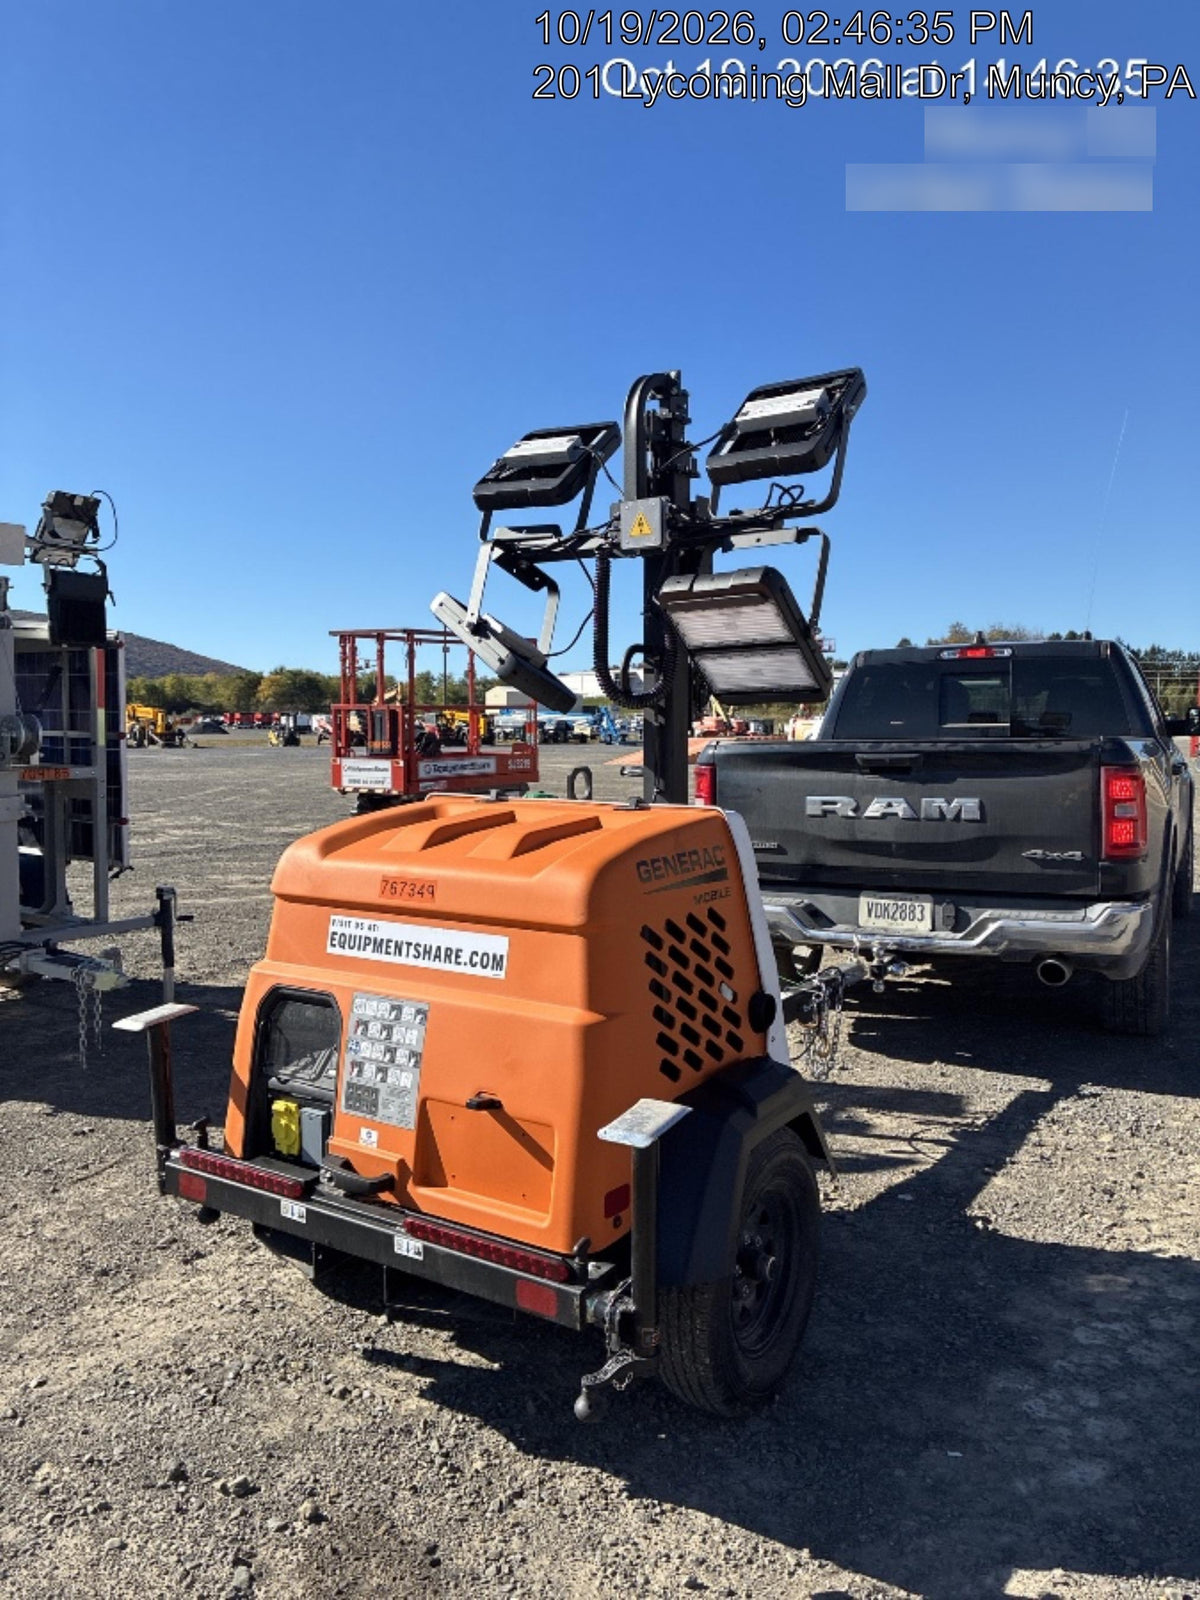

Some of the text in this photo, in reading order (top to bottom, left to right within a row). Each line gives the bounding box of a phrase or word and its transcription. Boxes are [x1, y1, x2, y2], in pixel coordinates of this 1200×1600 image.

[806, 795, 982, 821] RAM
[636, 845, 726, 883] GENERAC
[1020, 849, 1085, 861] 4x4
[381, 879, 436, 899] 767349
[693, 886, 732, 905] MOBILE
[867, 900, 926, 922] VDK2883
[329, 930, 505, 972] EQUIPMENTSHARE.COM
